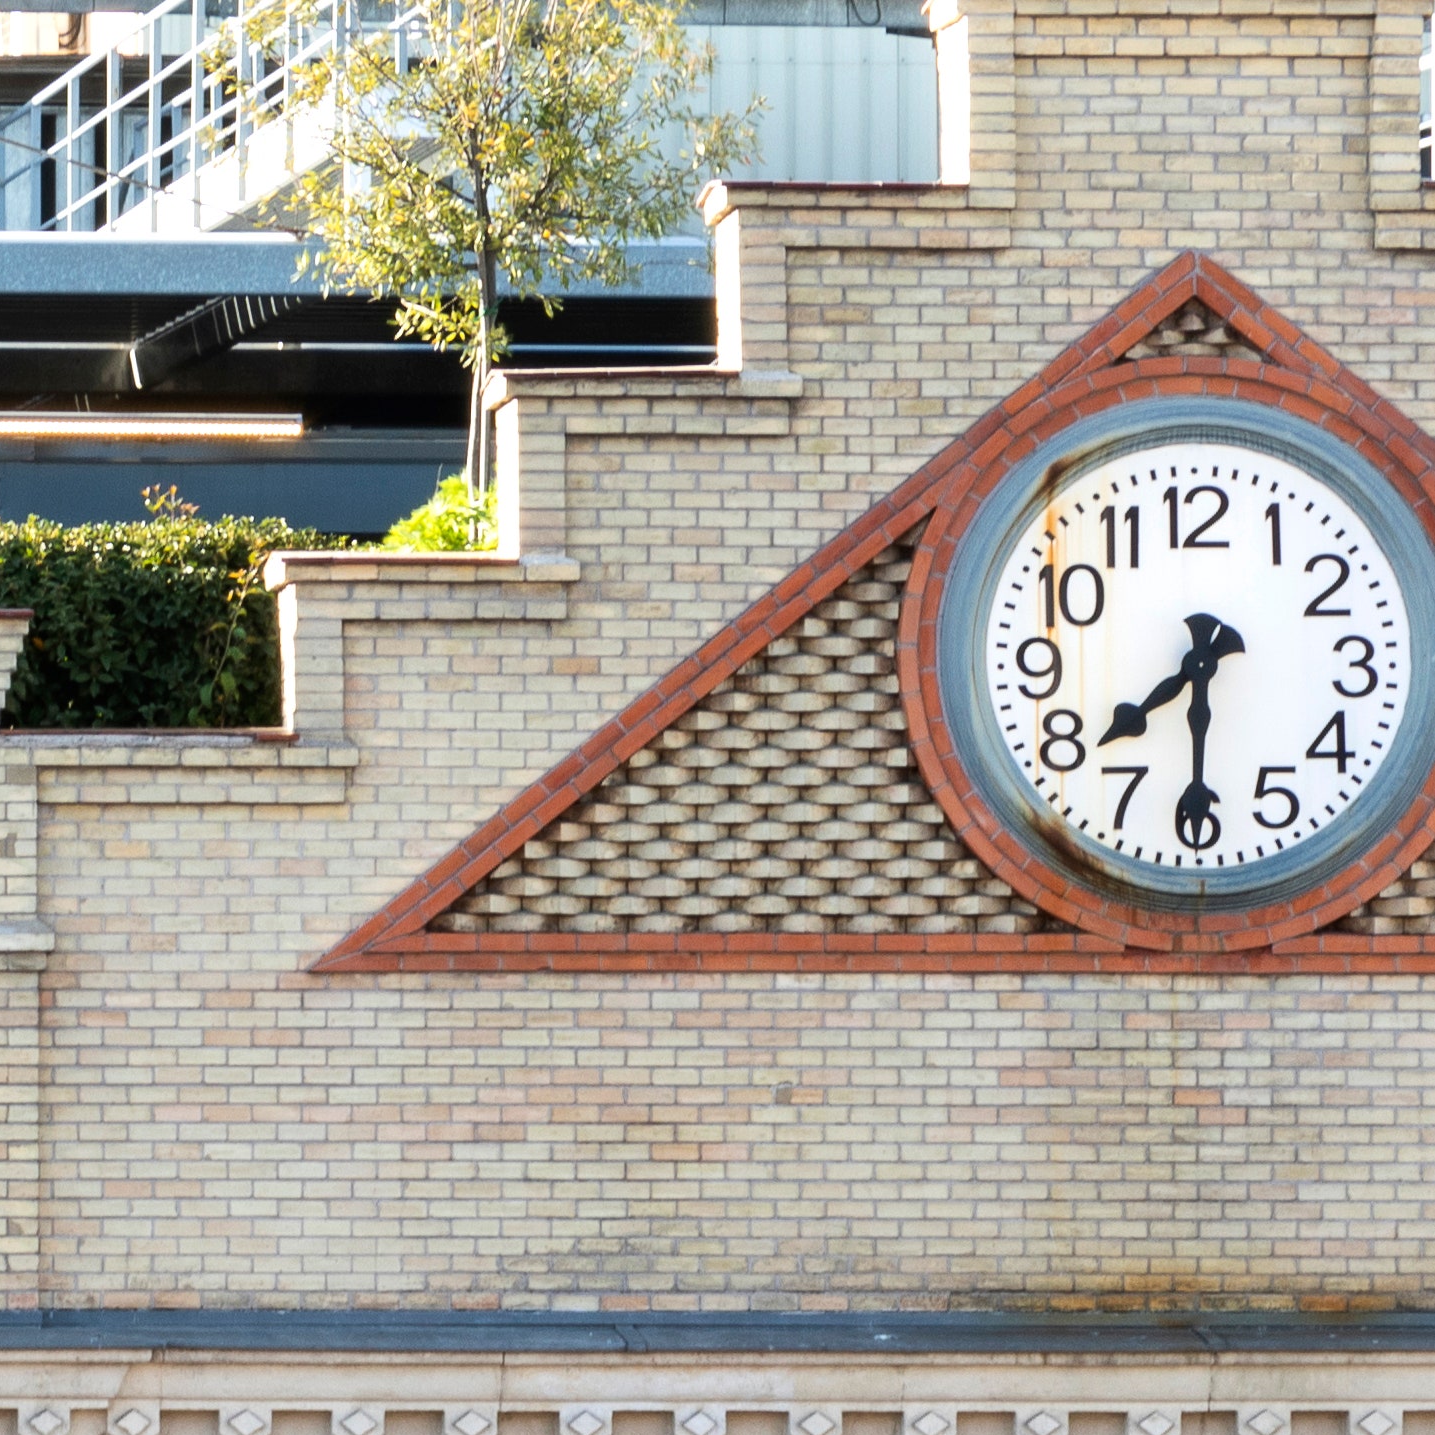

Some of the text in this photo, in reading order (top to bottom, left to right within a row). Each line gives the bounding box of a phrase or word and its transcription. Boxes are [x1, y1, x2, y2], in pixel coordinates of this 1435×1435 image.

[1101, 507, 1138, 567] 11
[1164, 486, 1229, 548] 12
[1266, 504, 1280, 564] 1
[1039, 564, 1104, 627] 10
[1305, 555, 1350, 616] 2
[1016, 638, 1062, 700] 9
[1333, 636, 1377, 697] 3
[1040, 710, 1085, 772] 8
[1306, 711, 1355, 773] 4
[1102, 767, 1148, 829] 7
[1253, 767, 1299, 828] 5
